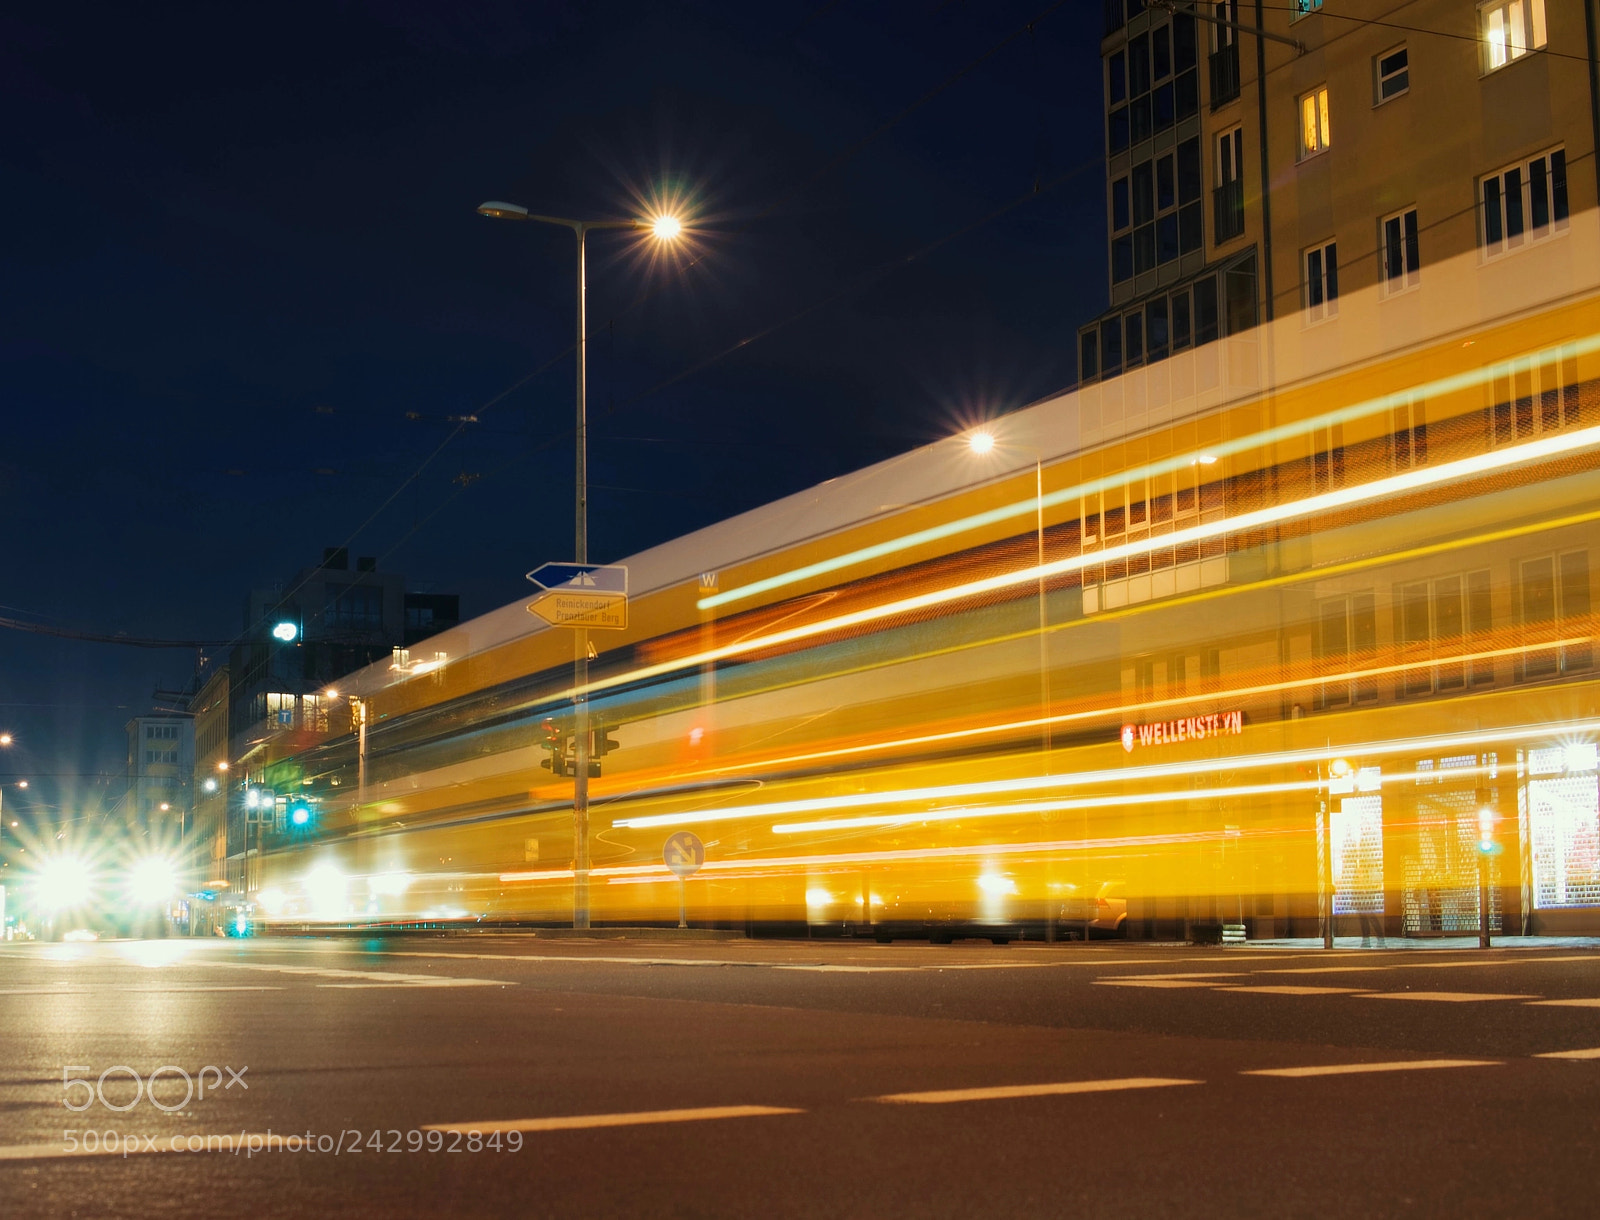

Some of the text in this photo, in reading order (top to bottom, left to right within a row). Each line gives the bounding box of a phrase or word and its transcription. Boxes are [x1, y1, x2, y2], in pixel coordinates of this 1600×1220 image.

[556, 598, 610, 609] Reinickendorf
[556, 610, 619, 625] Prenzlauer Berg
